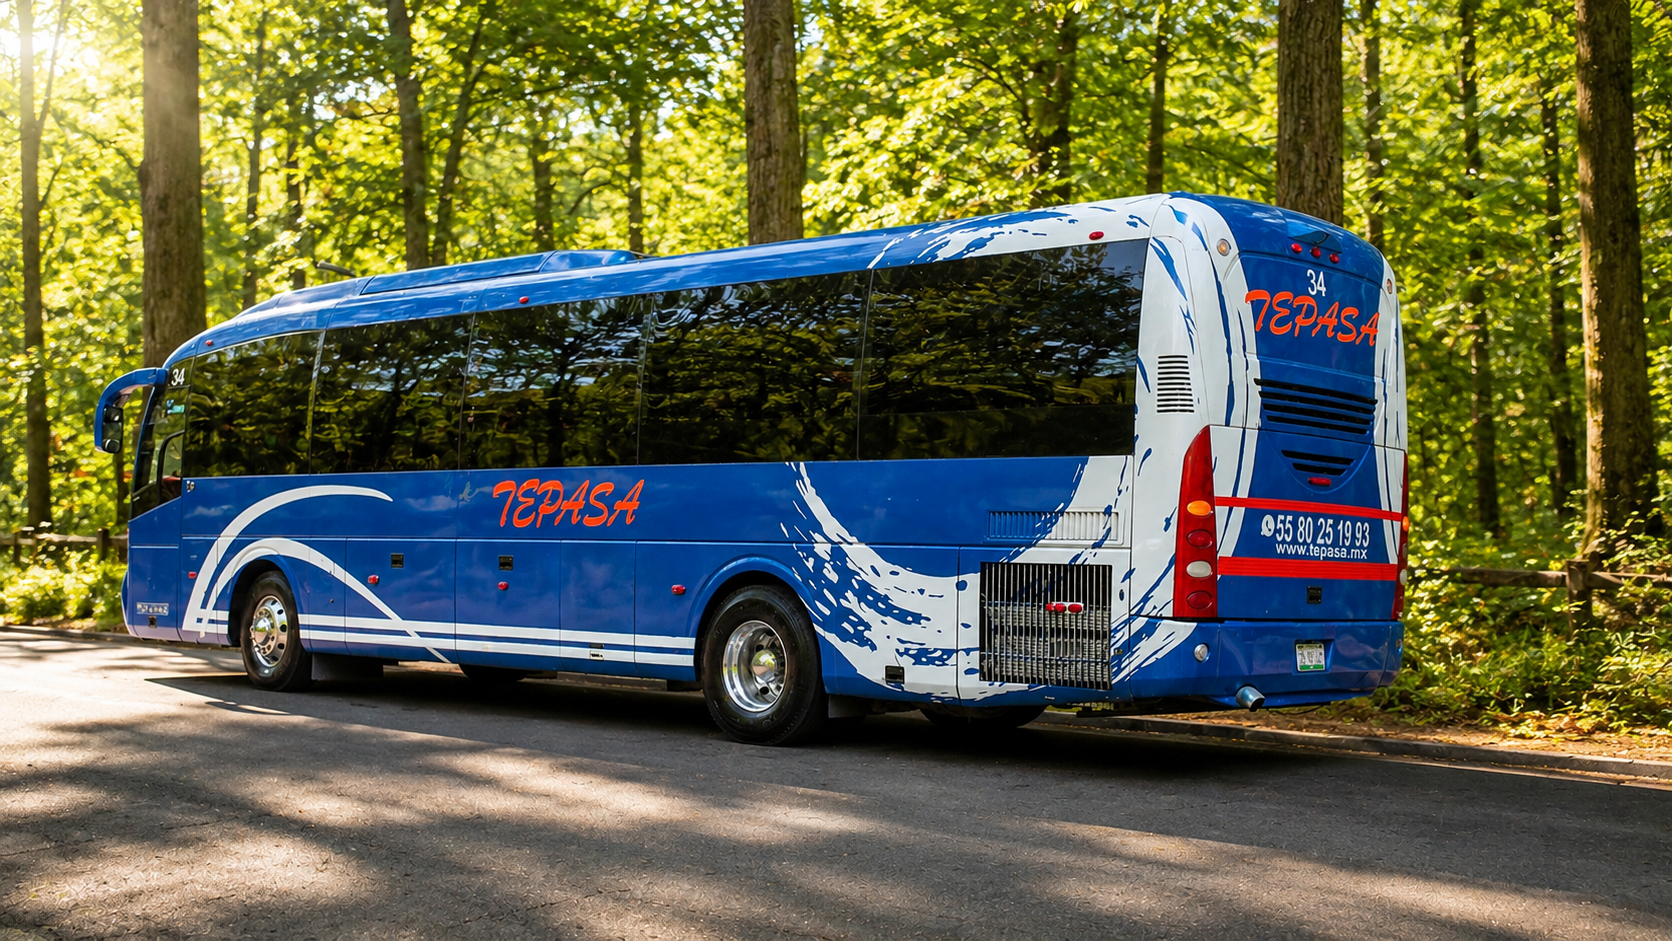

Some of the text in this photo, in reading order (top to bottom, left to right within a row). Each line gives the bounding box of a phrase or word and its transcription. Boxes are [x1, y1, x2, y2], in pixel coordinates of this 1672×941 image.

[1306, 269, 1327, 297] 34
[1245, 289, 1380, 346] TEPASA
[171, 368, 186, 386] 34
[492, 478, 645, 528] TEPASA
[1275, 514, 1370, 548] 55 80 25 19 93
[1275, 543, 1368, 560] www.tepasa.mx
